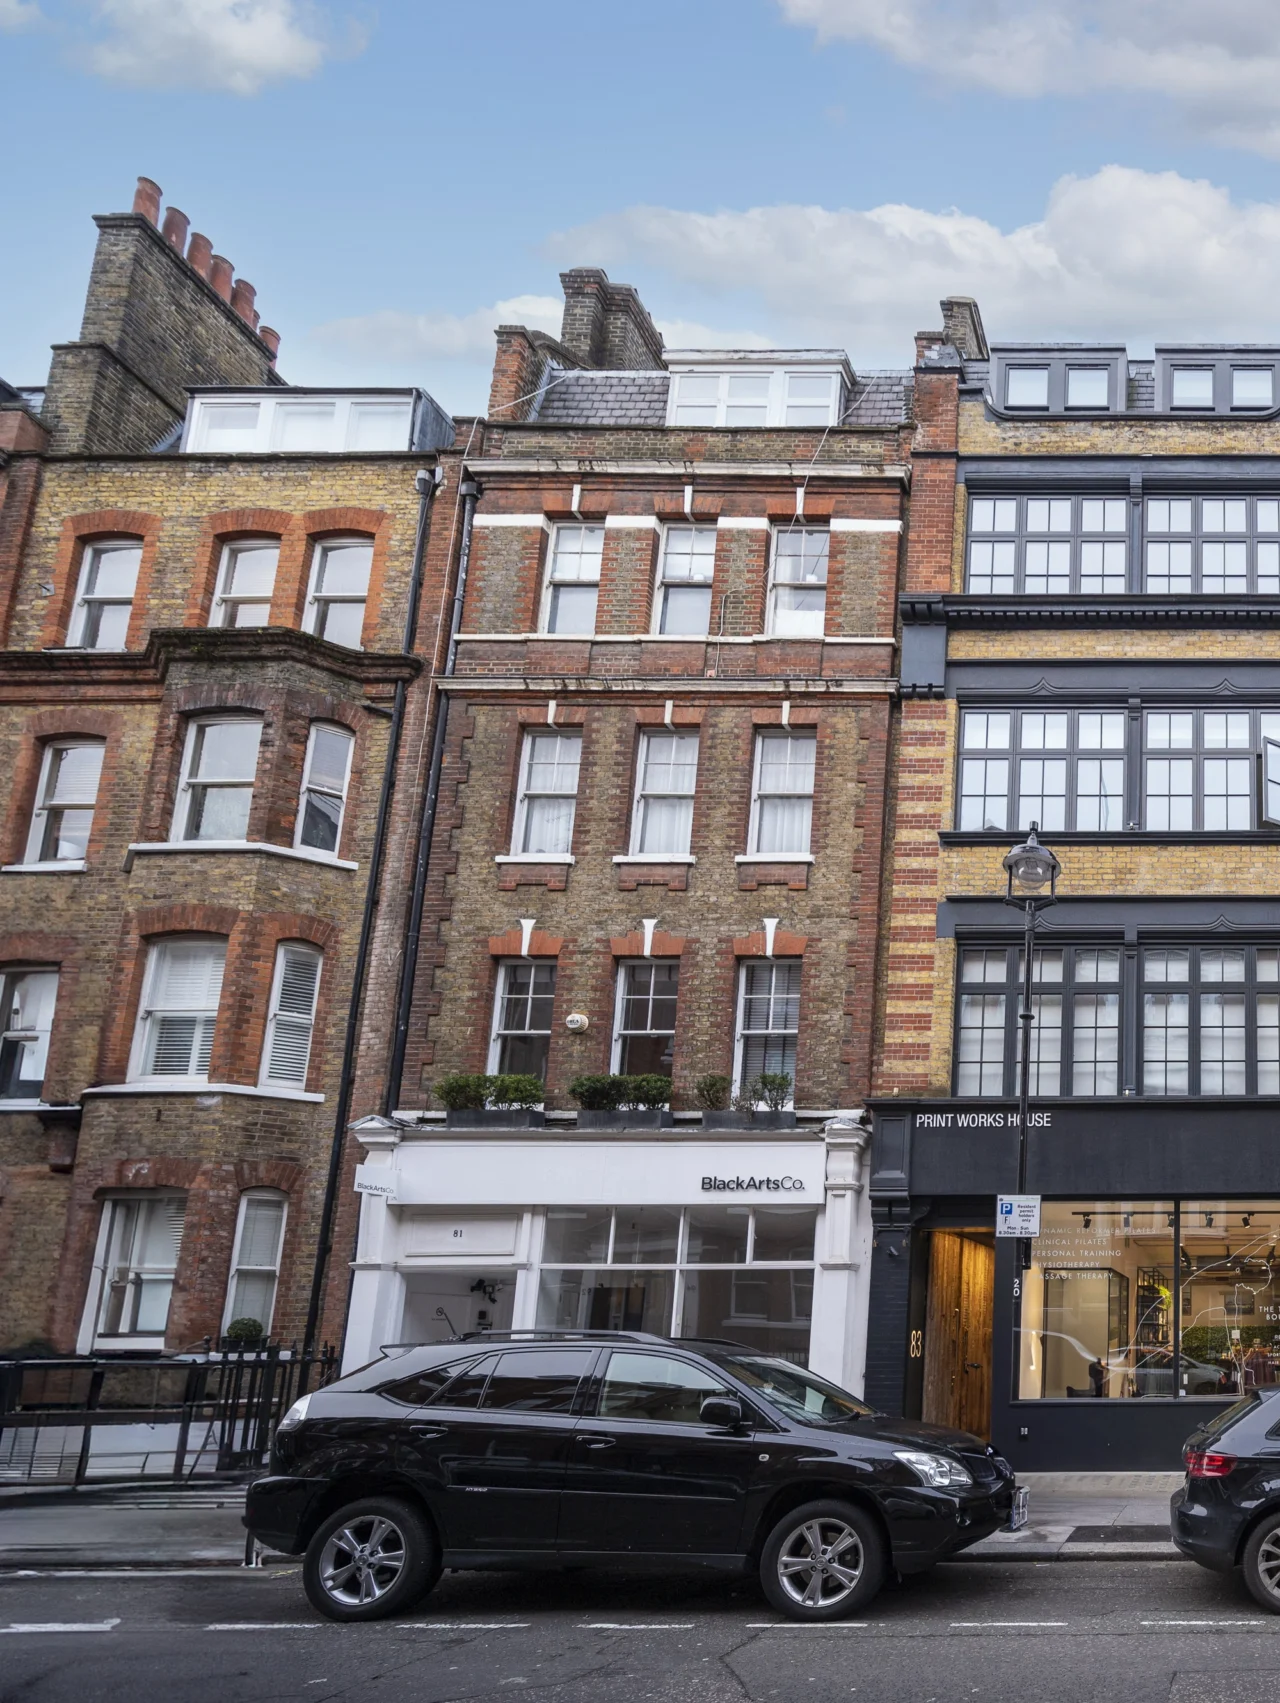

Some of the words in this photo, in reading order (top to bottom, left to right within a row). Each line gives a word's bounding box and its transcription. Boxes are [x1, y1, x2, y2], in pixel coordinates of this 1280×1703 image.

[916, 1113, 954, 1127] PRINT
[957, 1113, 1004, 1127] WORKS
[701, 1176, 806, 1191] BlackArtsCo.
[1002, 1204, 1011, 1214] P
[1004, 1216, 1009, 1224] F
[453, 1229, 463, 1238] 81
[1080, 1249, 1122, 1257] TRAINING
[1033, 1272, 1073, 1280] ASSAGE
[910, 1330, 922, 1358] 83
